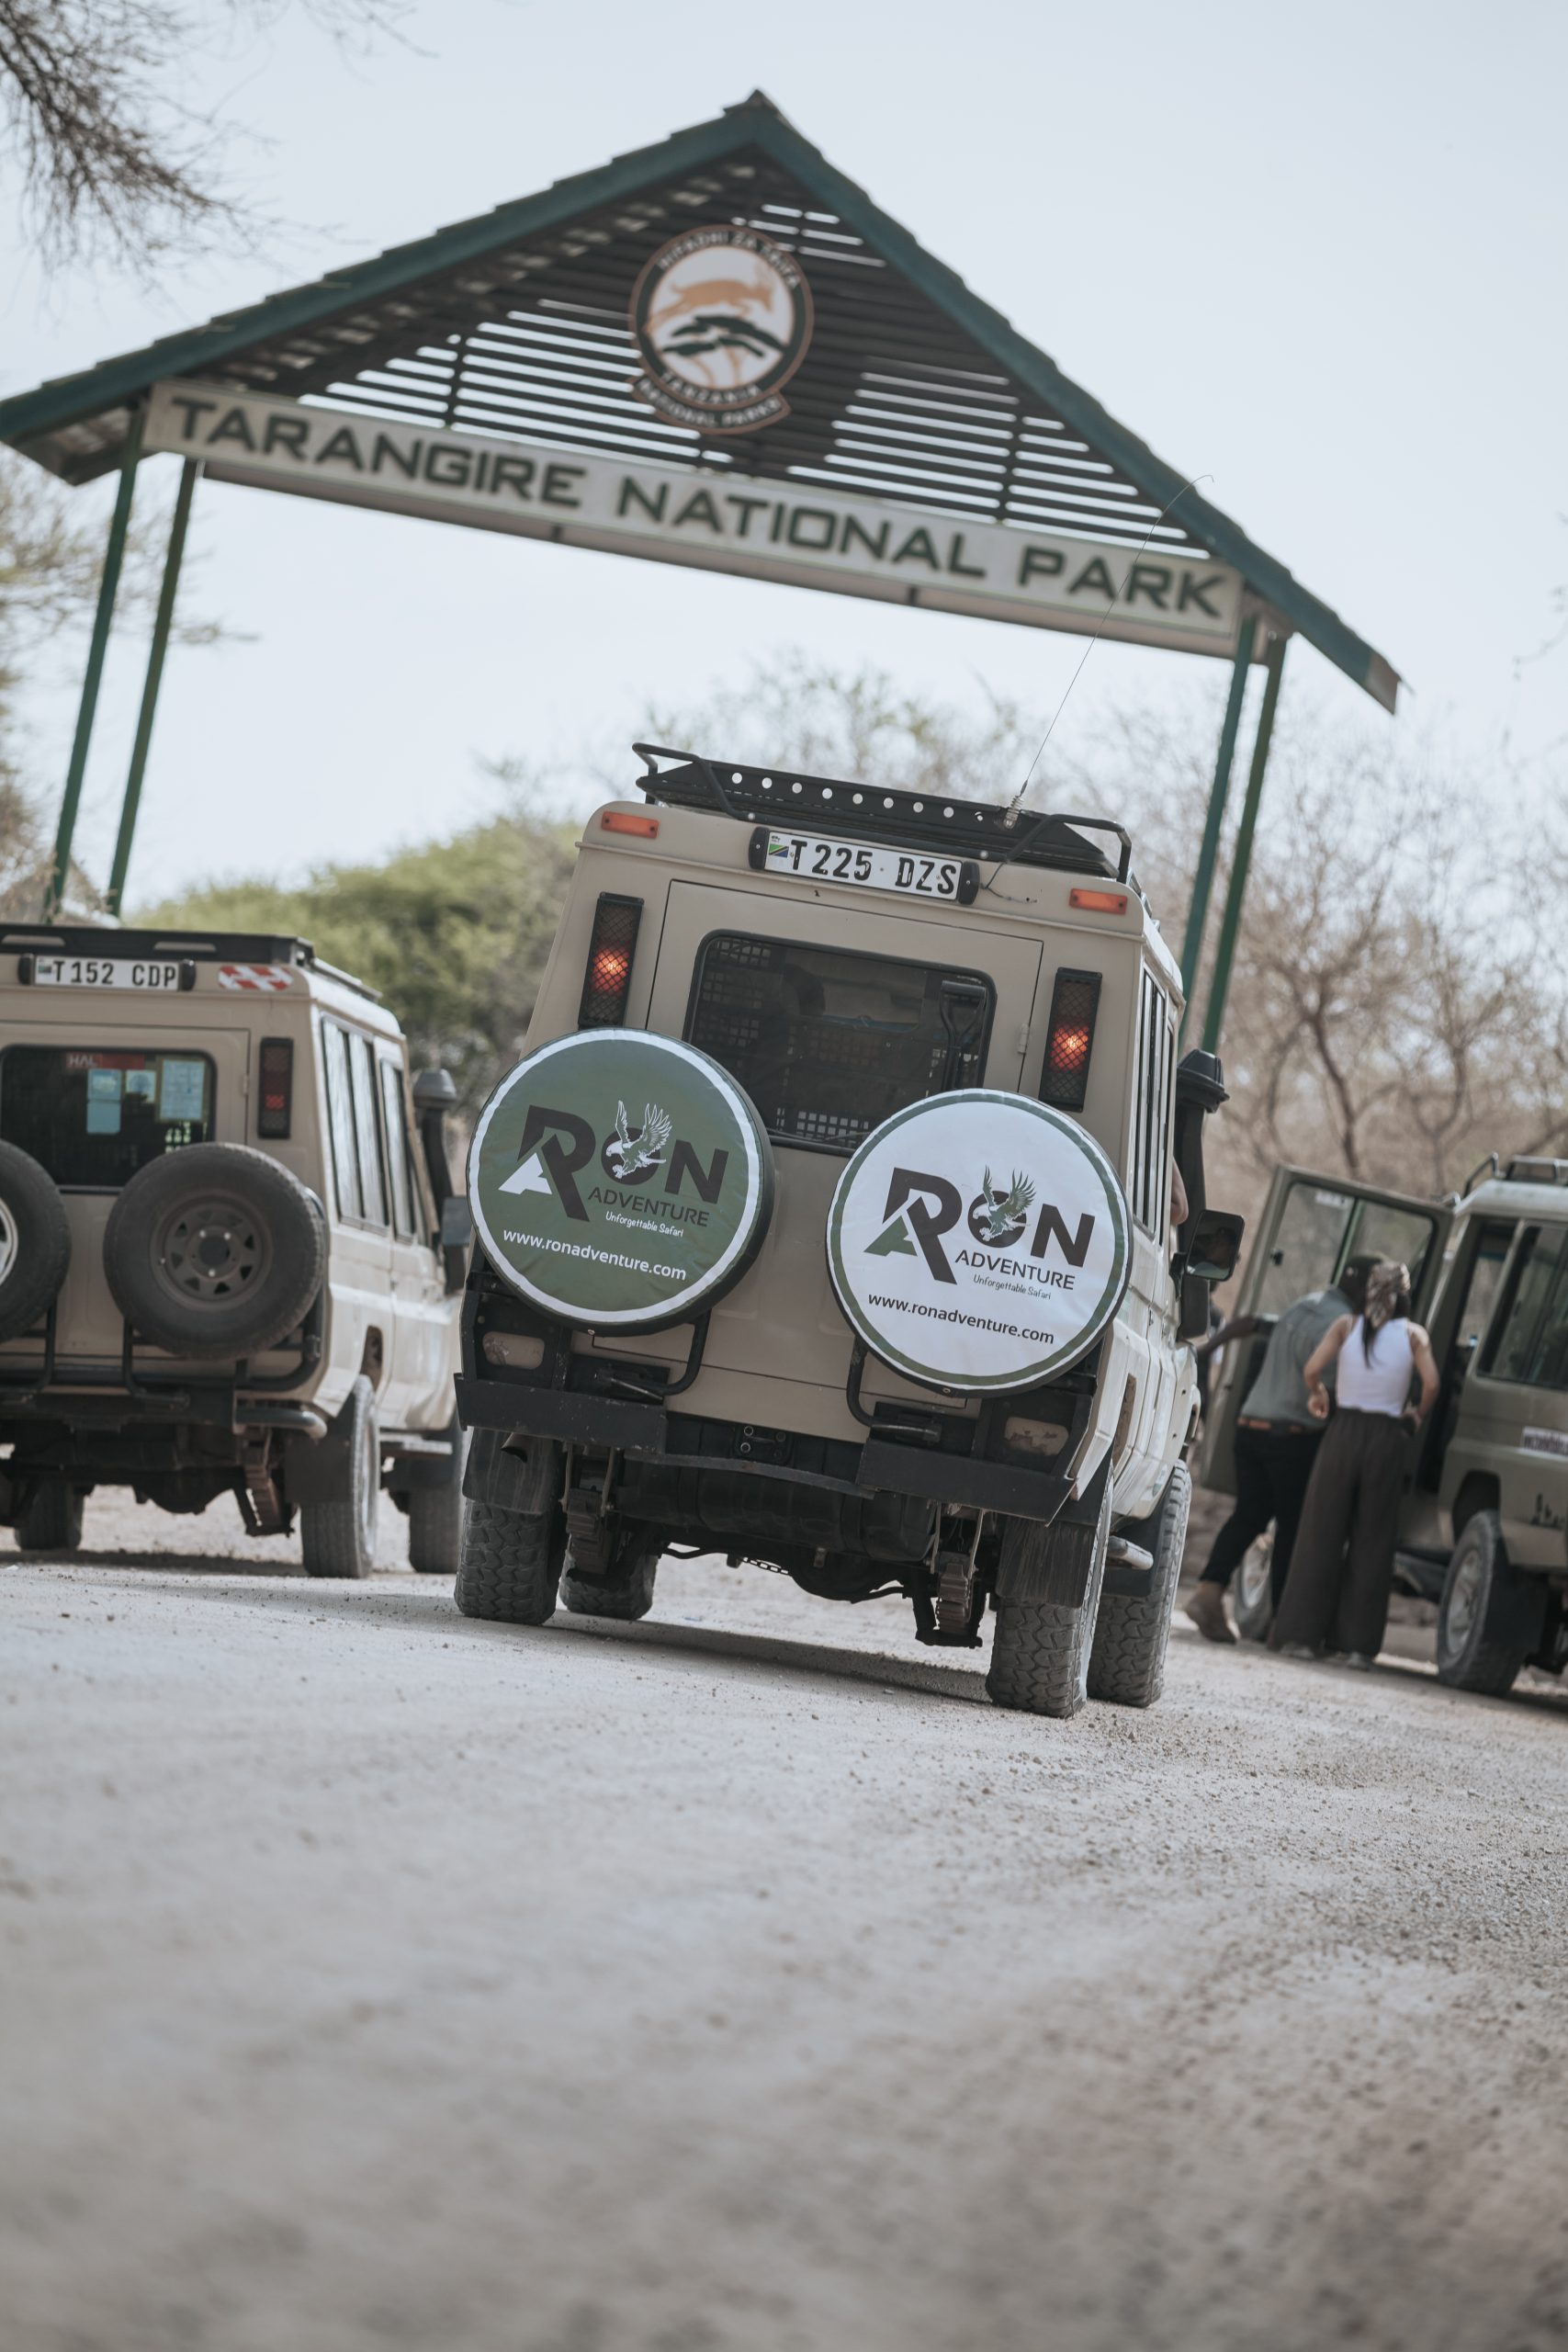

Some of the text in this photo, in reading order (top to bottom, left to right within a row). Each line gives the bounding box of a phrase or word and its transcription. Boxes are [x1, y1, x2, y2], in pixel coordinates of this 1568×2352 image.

[172, 396, 1223, 618] TARANGIRE NATIONAL PARK
[791, 839, 956, 895] T 225 DZS
[52, 961, 176, 988] T 152 CDP
[588, 1186, 710, 1227] ADVENTURE
[605, 1211, 684, 1238] Unforgettable Safari
[503, 1229, 687, 1281] www.ronadventure.com
[954, 1249, 1076, 1291] ADVENTURE
[973, 1273, 1052, 1300] Unforgettable Safari
[867, 1293, 1055, 1345] www.ronadventure.com
